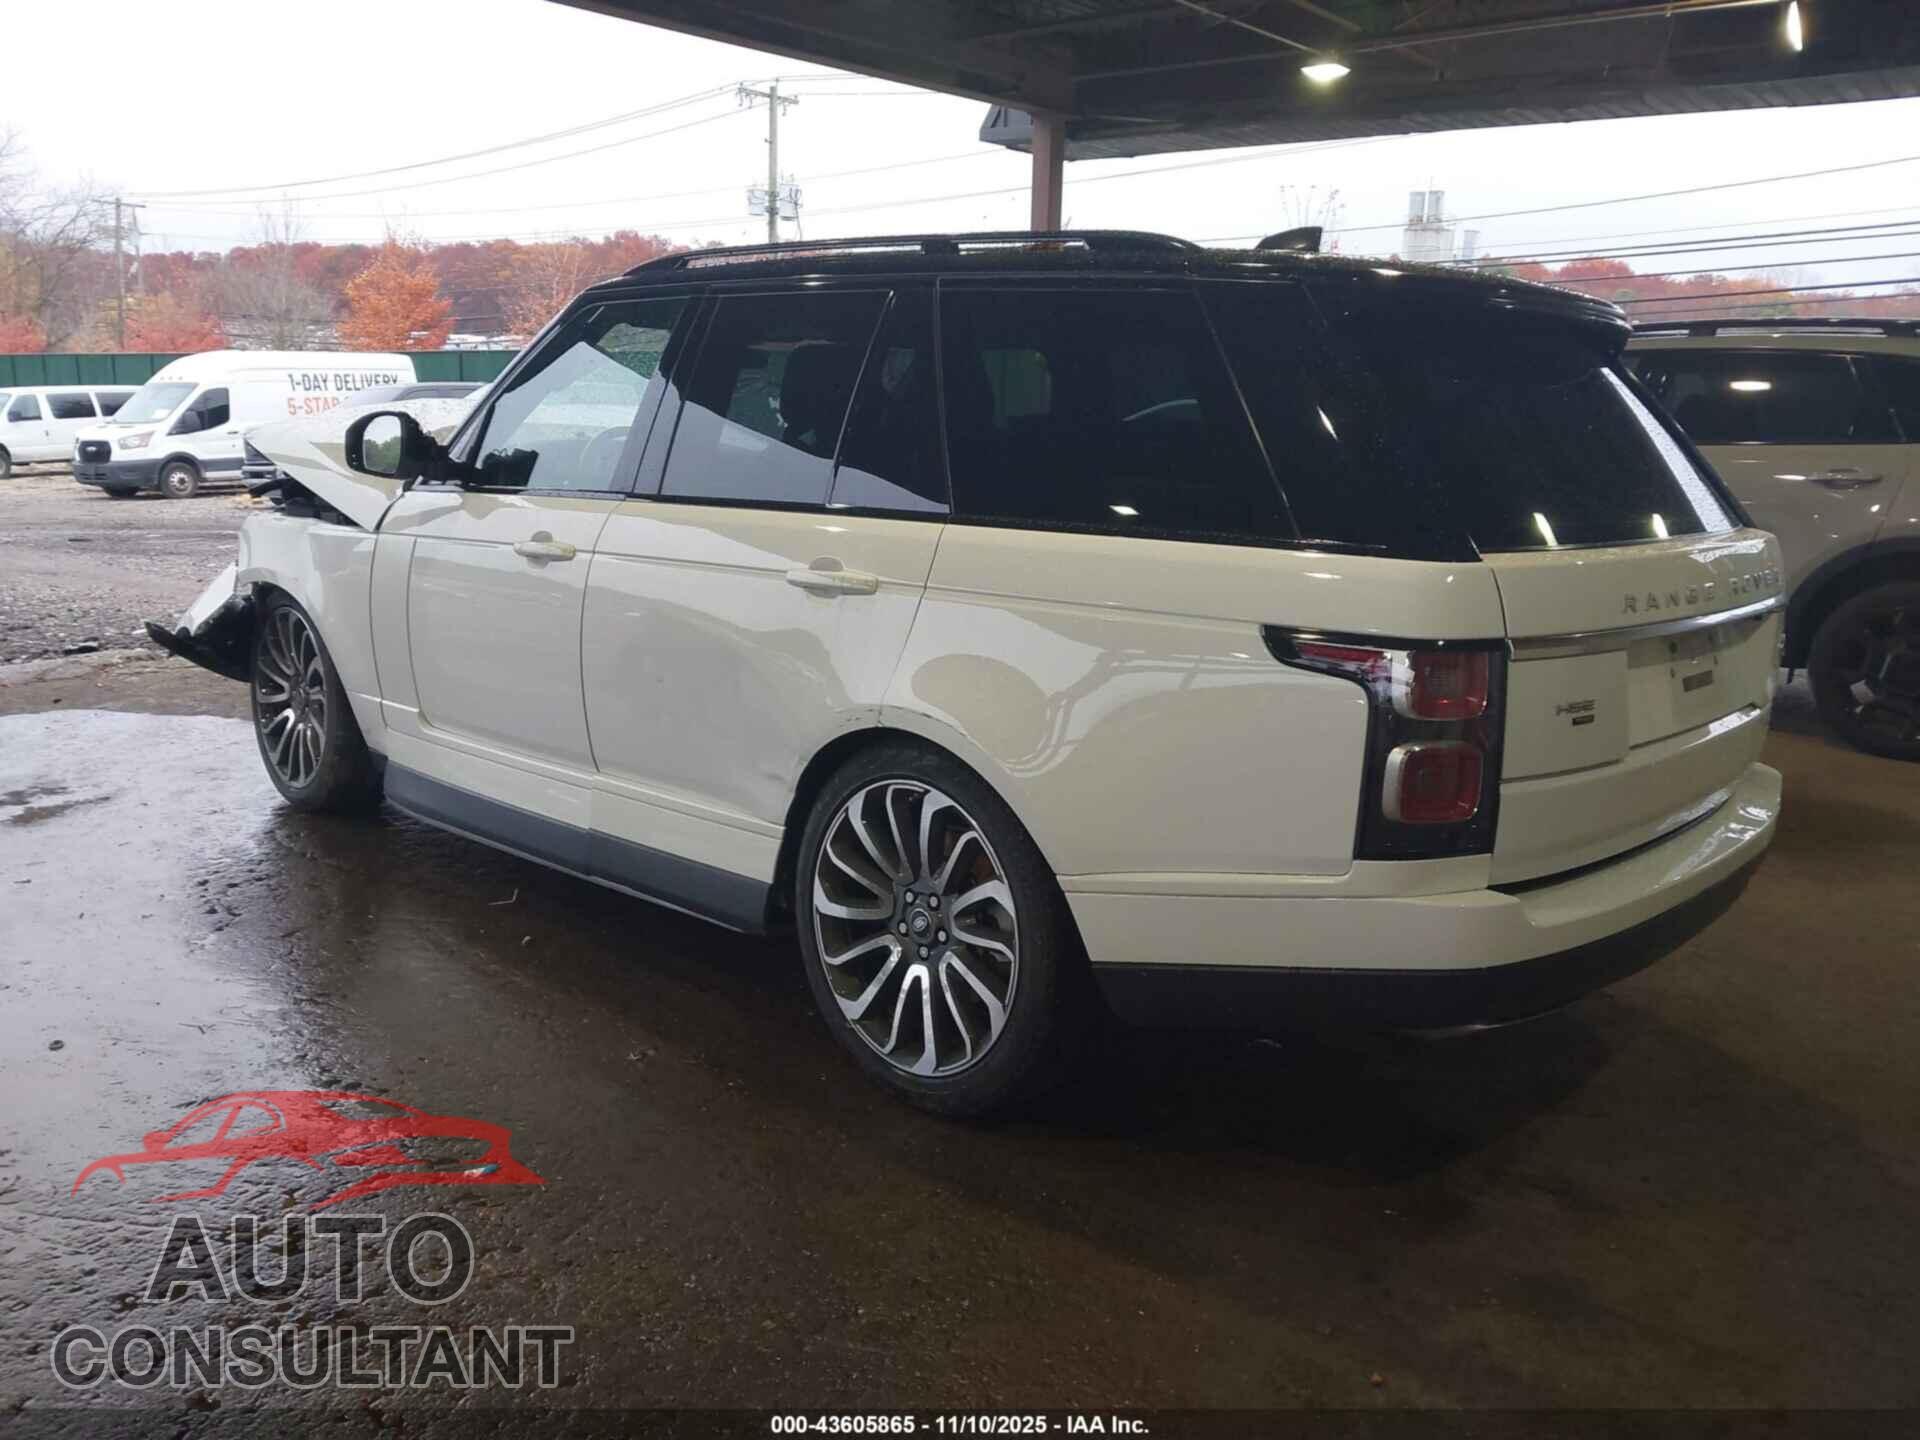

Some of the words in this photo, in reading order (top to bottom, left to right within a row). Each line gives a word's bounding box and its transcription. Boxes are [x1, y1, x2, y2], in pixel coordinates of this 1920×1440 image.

[288, 374, 329, 391] 1-DAY
[334, 374, 398, 391] DELIVERY
[1622, 582, 1715, 614] RANGE
